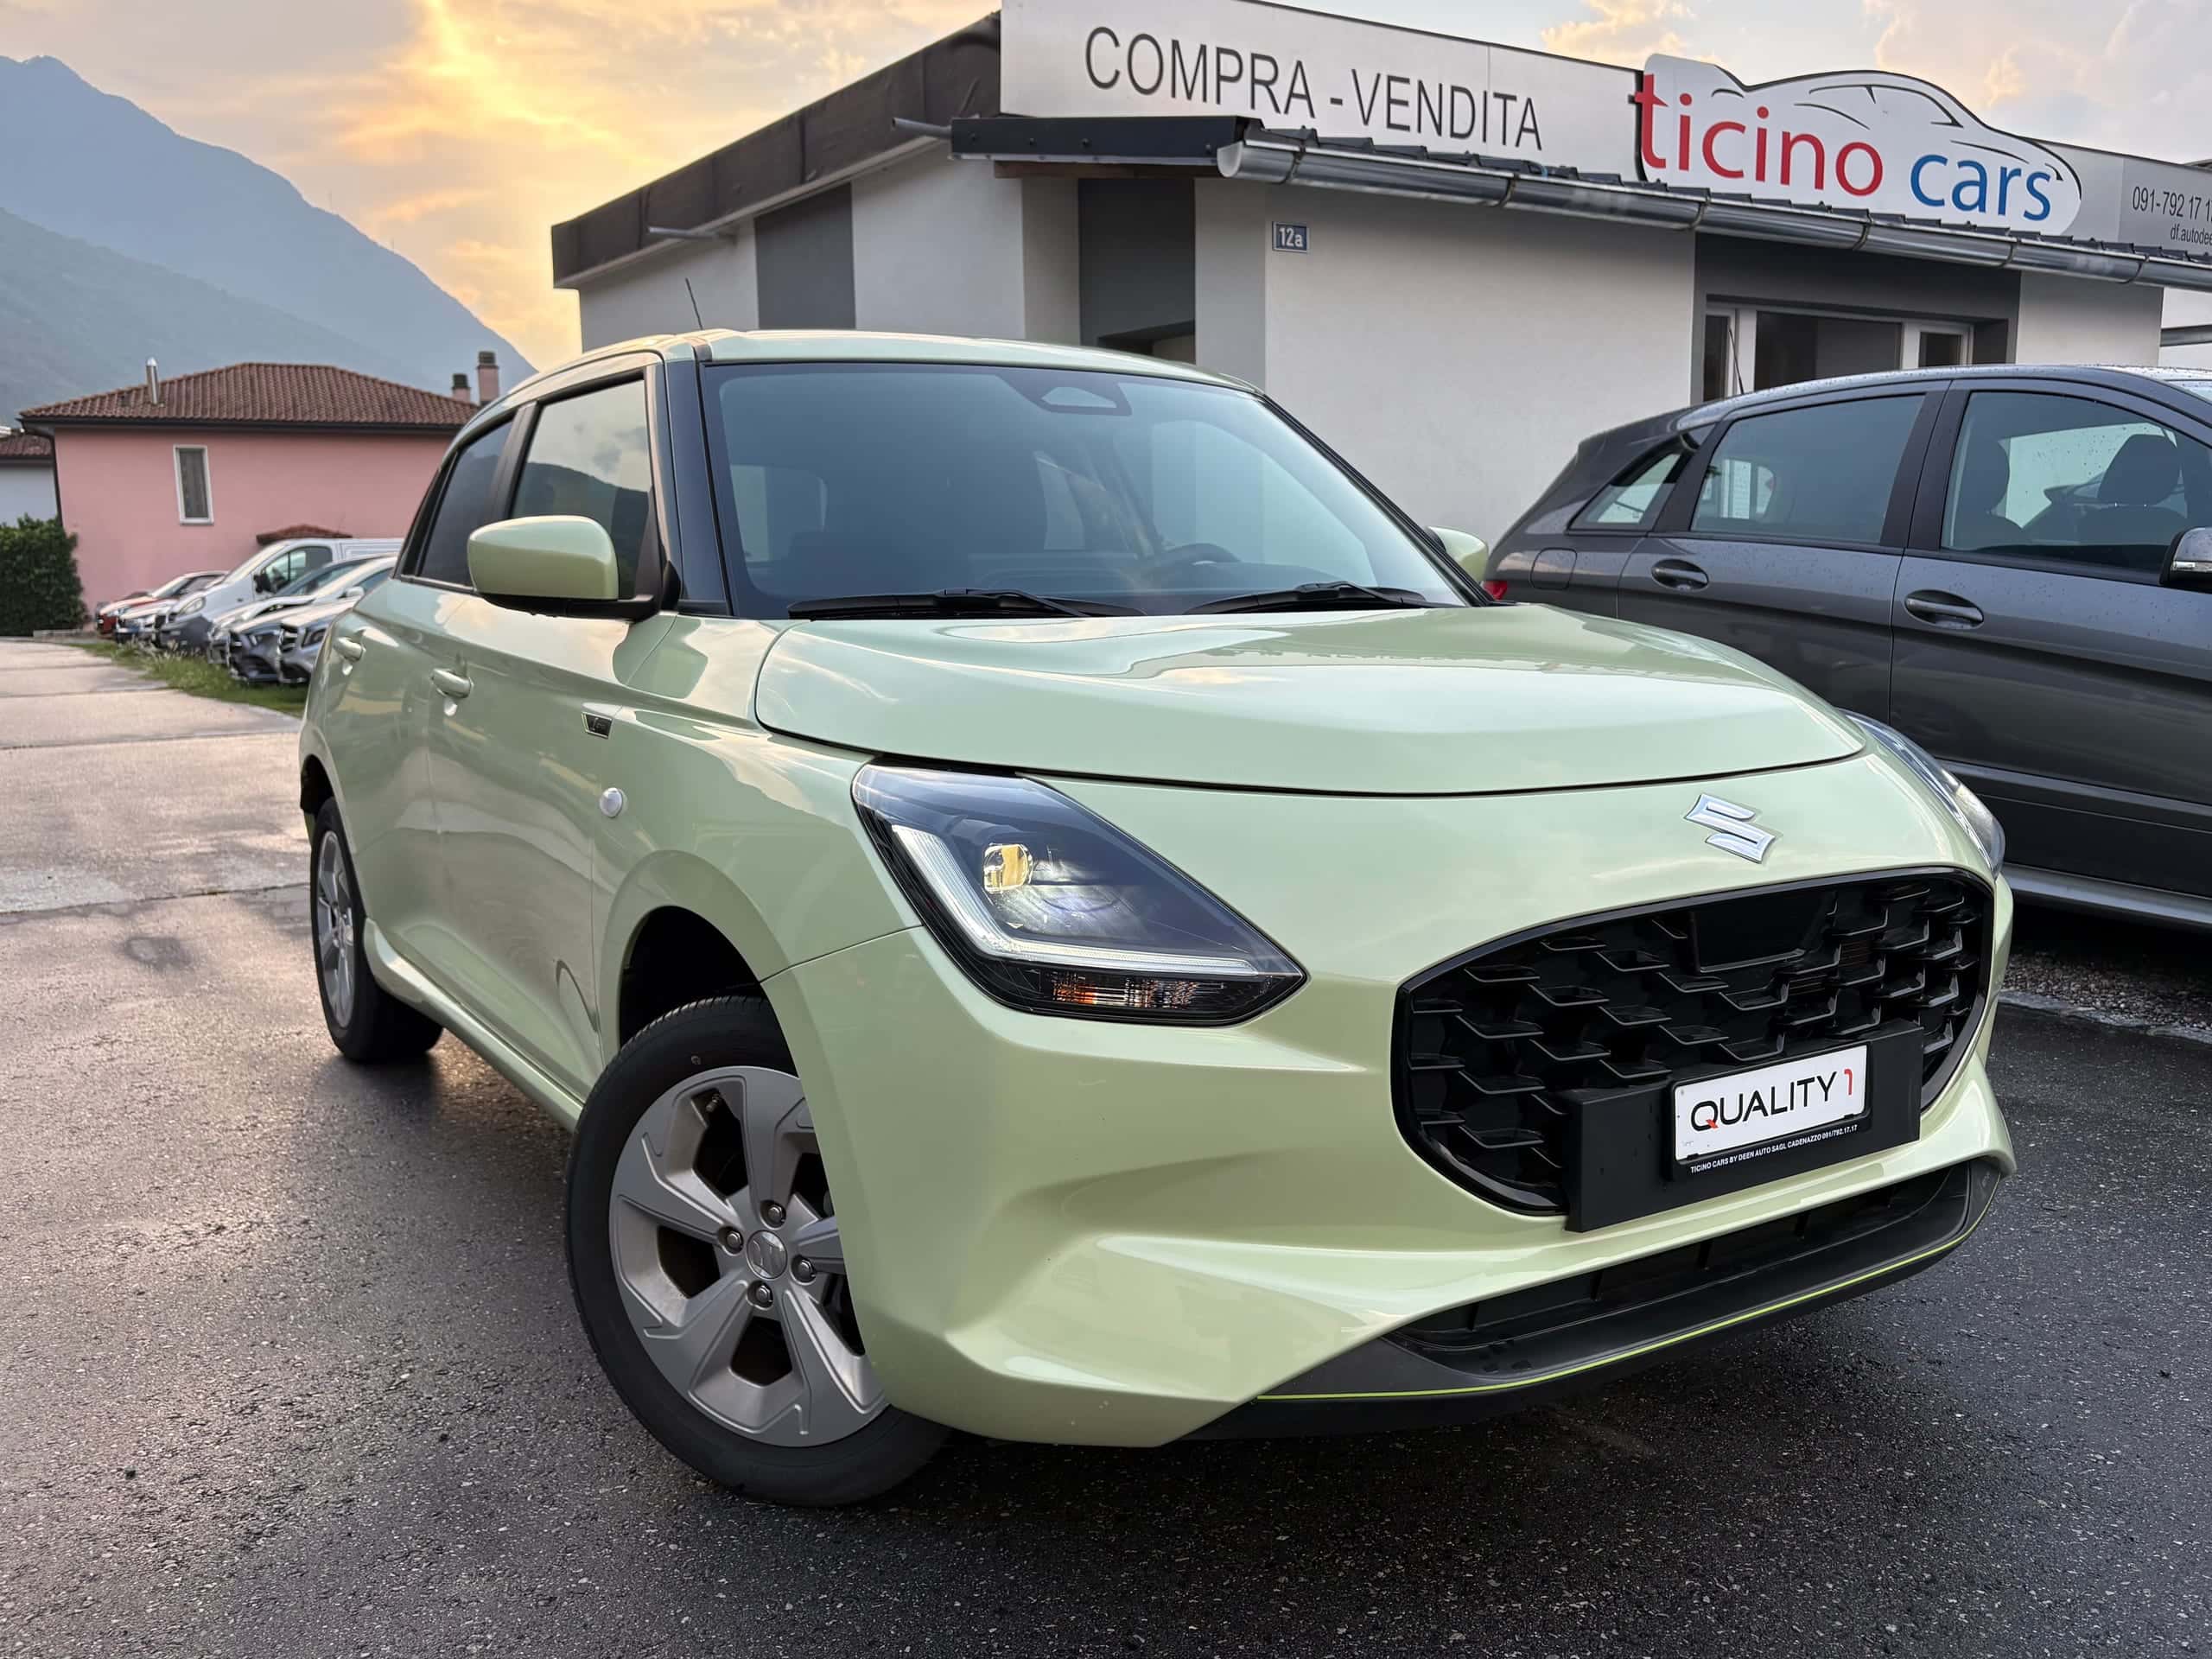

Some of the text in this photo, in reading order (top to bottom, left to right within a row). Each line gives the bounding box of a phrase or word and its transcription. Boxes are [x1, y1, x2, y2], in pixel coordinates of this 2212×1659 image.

[1085, 26, 1316, 118] COMPRA
[1351, 68, 1543, 150] VENDITA
[1630, 73, 2052, 221] ticino cars
[2133, 186, 2212, 223] 091-792 17 1
[1278, 227, 1304, 248] 12a
[1690, 1068, 1853, 1132] QUALITY 1
[1690, 1161, 1712, 1174] TICINO
[1712, 1157, 1729, 1167] CARS
[1729, 1154, 1738, 1163] BY
[1738, 1150, 1755, 1161] DEEN
[1755, 1147, 1771, 1158] AUTO
[1771, 1142, 1787, 1153] SAGL
[1787, 1133, 1821, 1148] CADENAZZO
